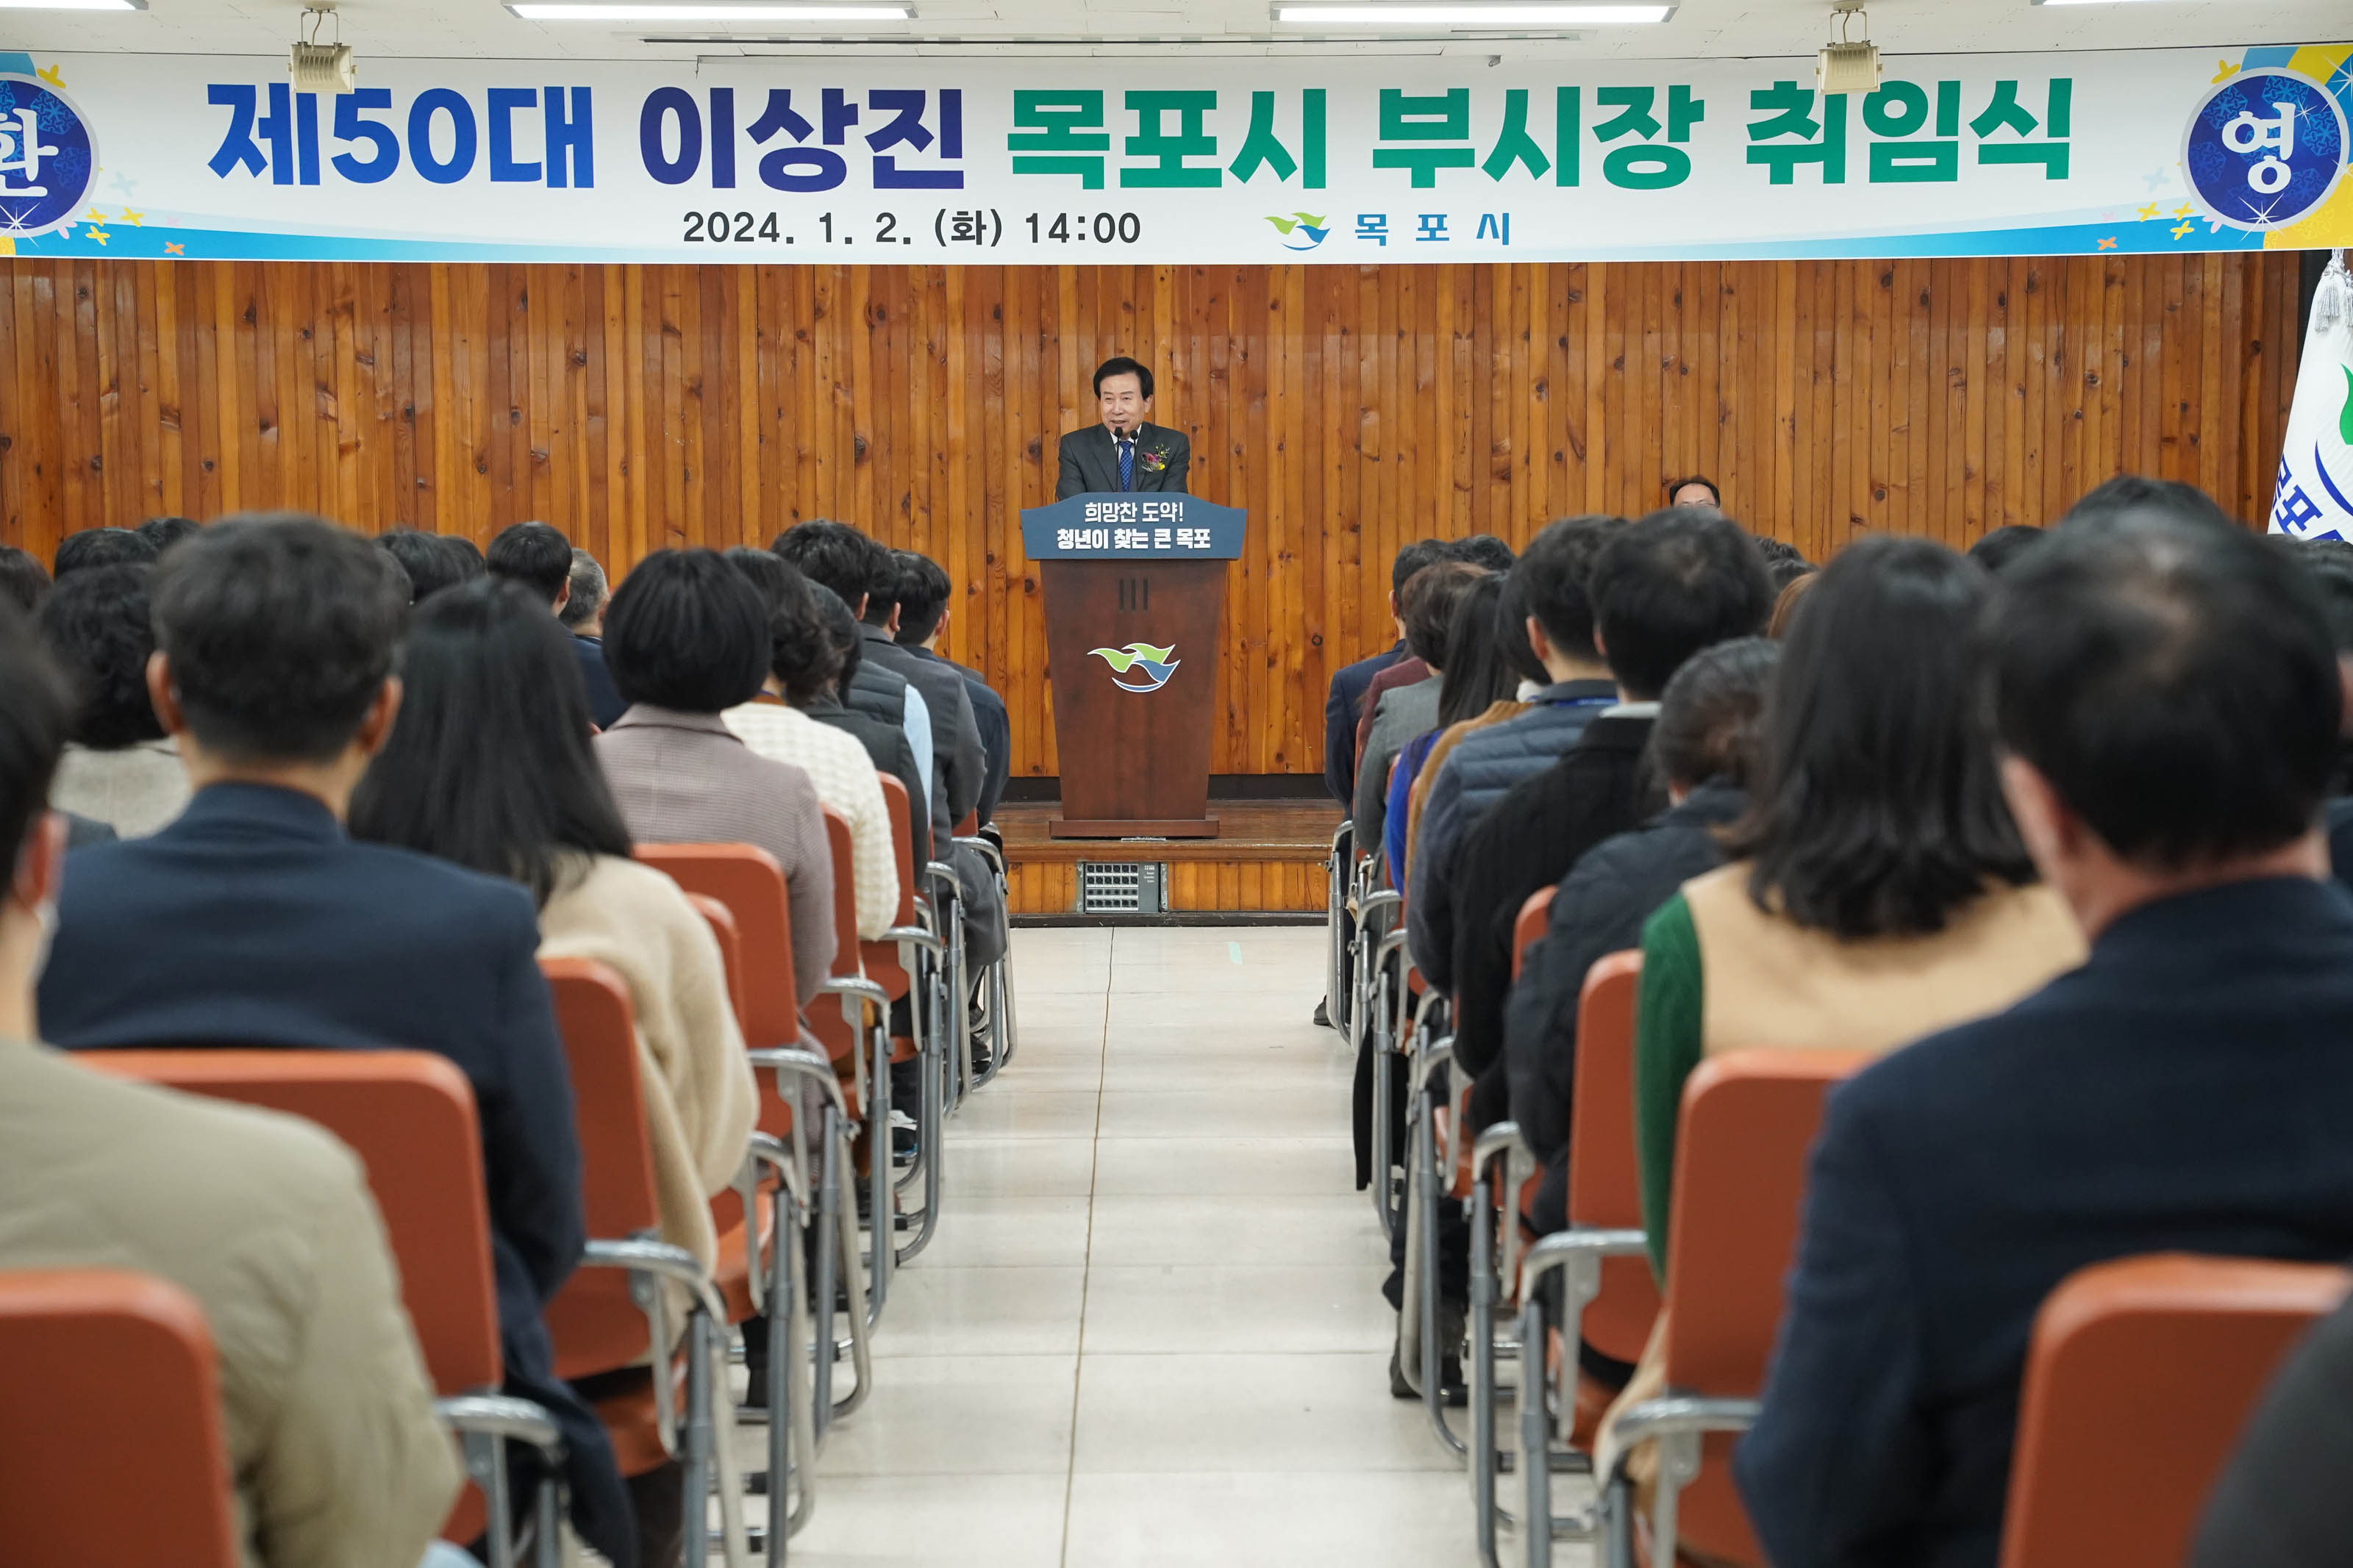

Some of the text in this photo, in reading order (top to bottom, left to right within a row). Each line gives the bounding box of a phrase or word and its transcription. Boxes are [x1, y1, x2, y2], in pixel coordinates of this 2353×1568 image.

[207, 78, 2073, 193] 제50대 이상진 목포시 부시장 취임식
[2221, 101, 2295, 194] 영
[683, 208, 1141, 247] 2024. 1. 2. (화) 14:00
[1085, 501, 1184, 523] 희망찬 도약!
[1057, 528, 1211, 550] 청년이 찾는 큰 목포
